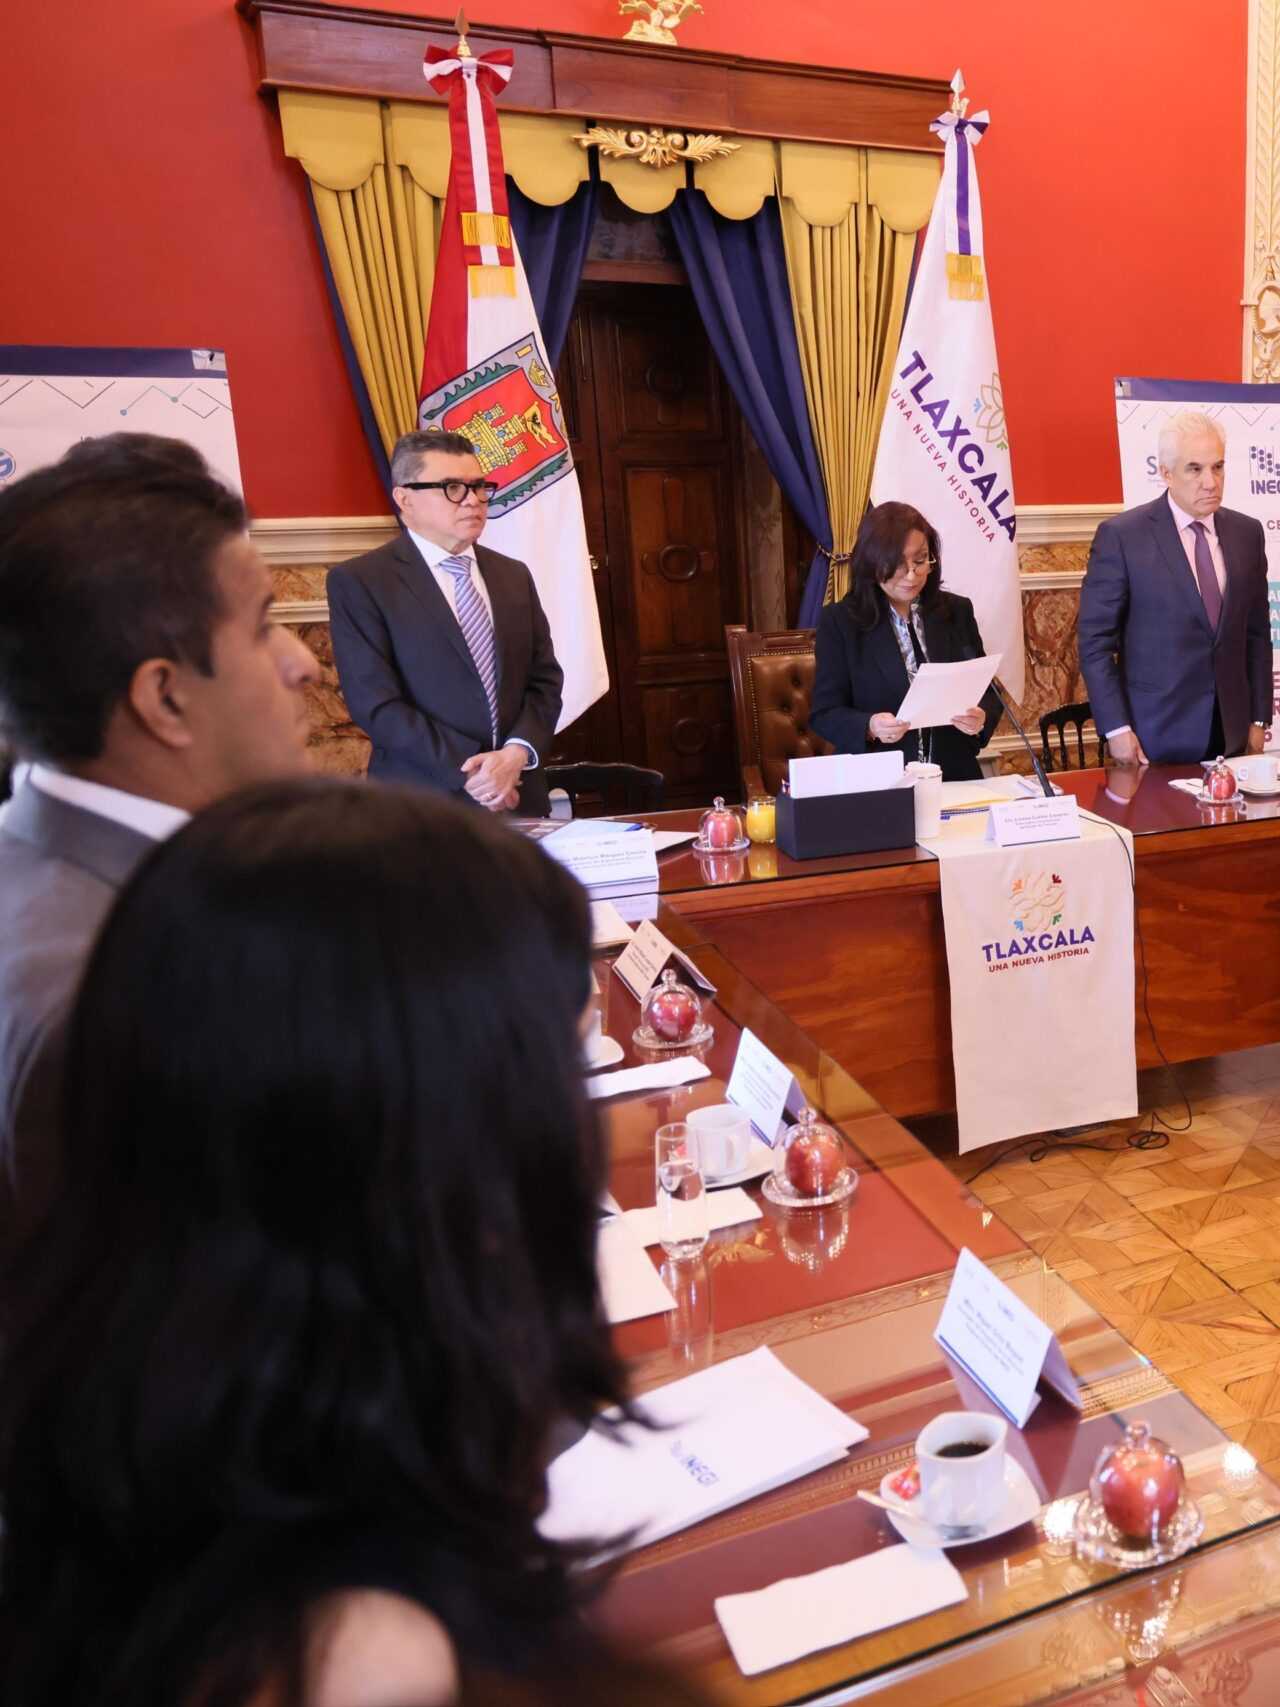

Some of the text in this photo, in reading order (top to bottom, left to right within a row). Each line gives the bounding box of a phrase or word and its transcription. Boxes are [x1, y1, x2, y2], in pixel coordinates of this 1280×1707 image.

[891, 388, 996, 543] UNA NUEVA HISTORIA
[900, 350, 1016, 542] TLAXCALA
[982, 925, 1095, 962] TLAXCALA
[988, 947, 1090, 973] UNA NUEVA HISTORIA
